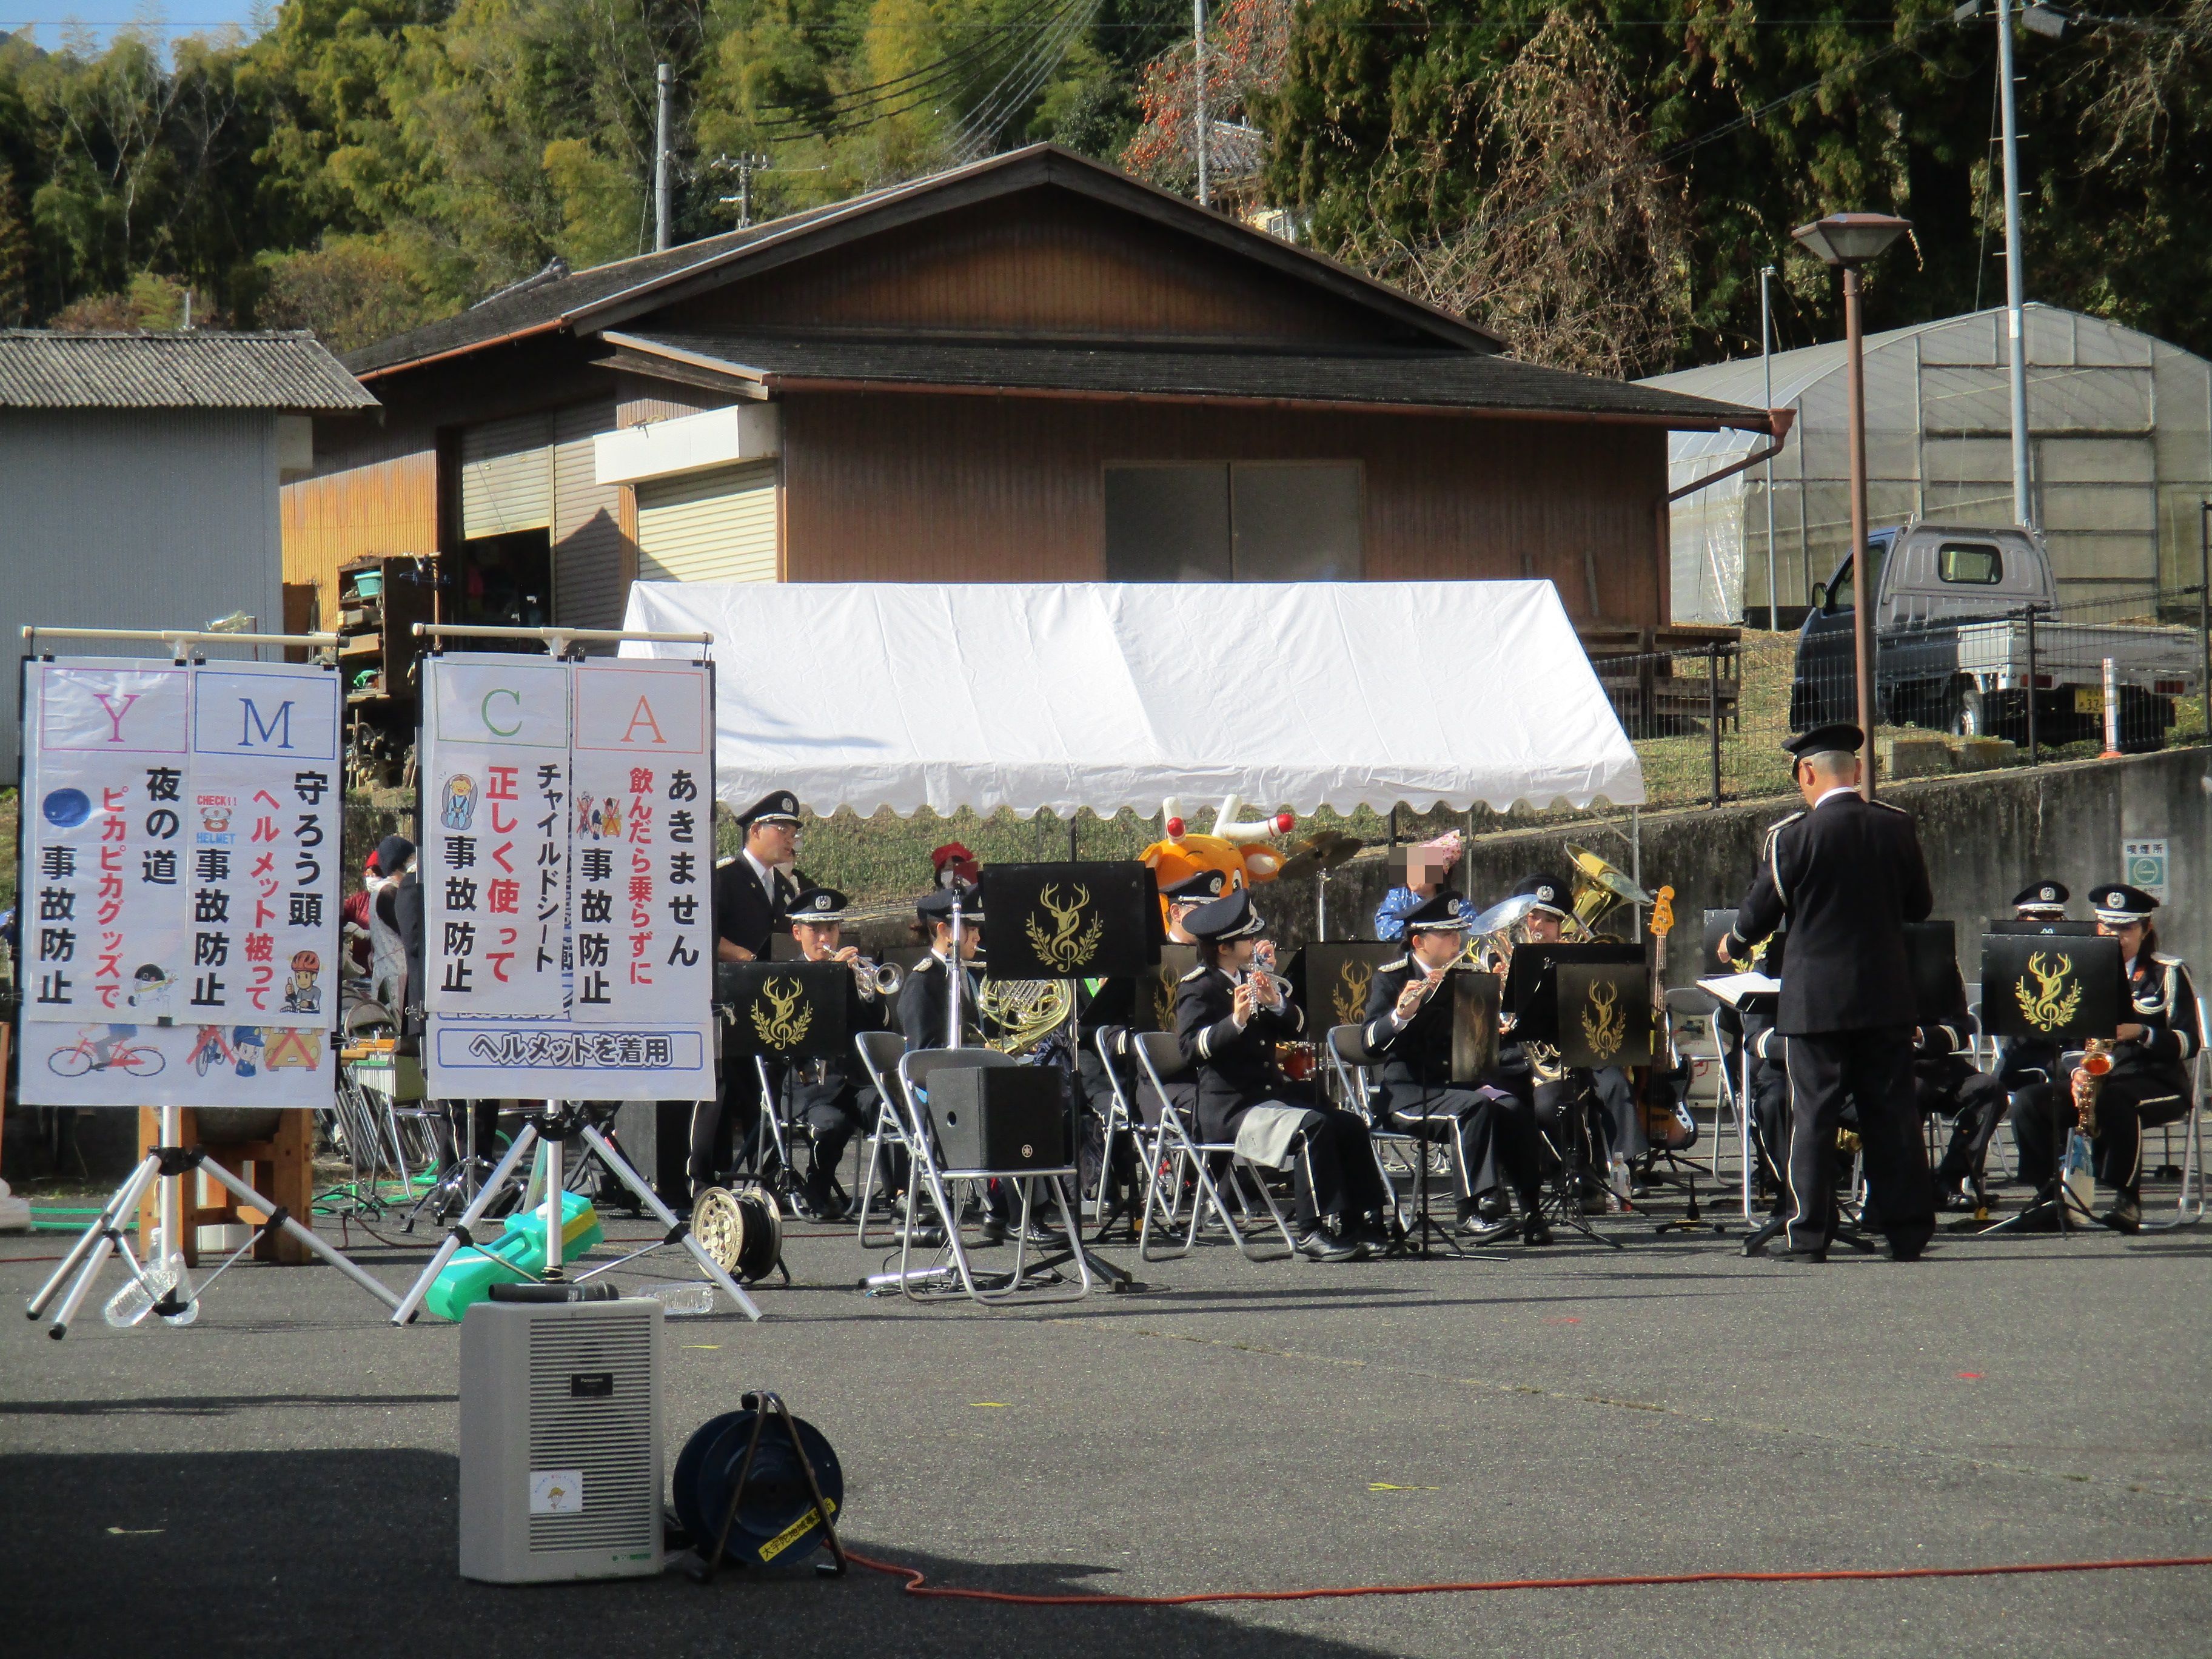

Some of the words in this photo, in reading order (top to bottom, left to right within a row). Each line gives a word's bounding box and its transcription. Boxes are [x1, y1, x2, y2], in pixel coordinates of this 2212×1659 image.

[94, 694, 140, 743] Y
[238, 698, 295, 749] M
[481, 688, 523, 737] C
[620, 695, 668, 744] A
[142, 767, 181, 884] 夜の道
[196, 833, 236, 844] HELMET
[197, 796, 237, 806] CHECK!!
[289, 771, 328, 927] 守ろう頭
[486, 766, 520, 982] 正しく使って
[537, 764, 563, 973] チャイルドシート
[629, 768, 653, 984] 飲んだら乗らずに
[668, 769, 699, 966] あきません
[38, 846, 76, 1004] 事故防止
[95, 786, 128, 1009] ピカピカグッズで
[190, 849, 230, 1006] 事故防止
[245, 789, 280, 1010] ヘルメット被って
[441, 836, 477, 993] 事故防止
[580, 848, 612, 1004] 事故防止
[470, 1033, 672, 1066] ヘルメットを着用
